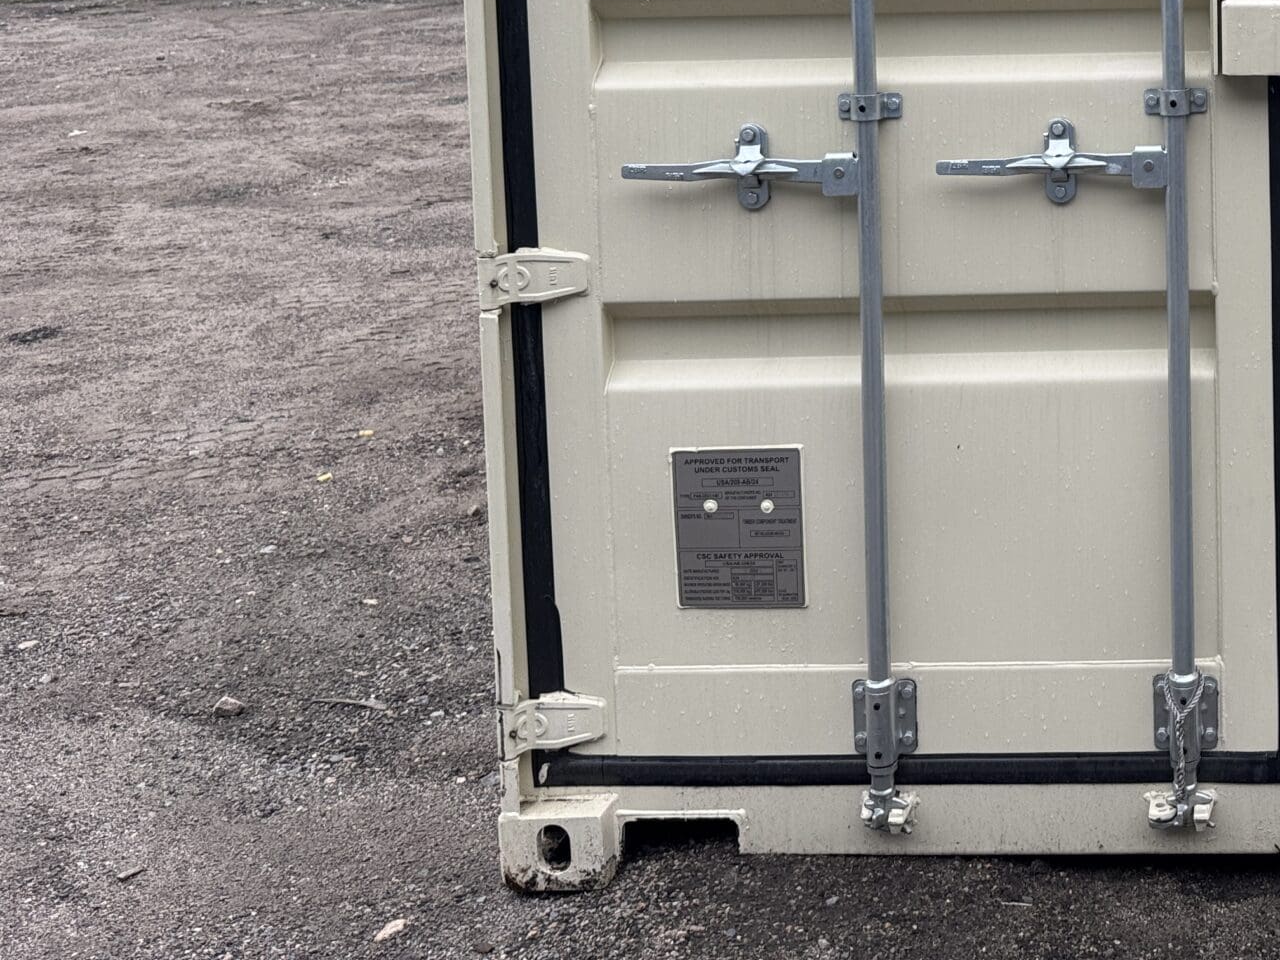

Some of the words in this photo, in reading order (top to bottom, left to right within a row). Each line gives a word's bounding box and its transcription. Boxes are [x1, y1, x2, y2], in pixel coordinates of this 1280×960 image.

[684, 458, 725, 466] APPROVED
[744, 456, 789, 464] TRANSPORT
[722, 465, 759, 473] CUSTOMS
